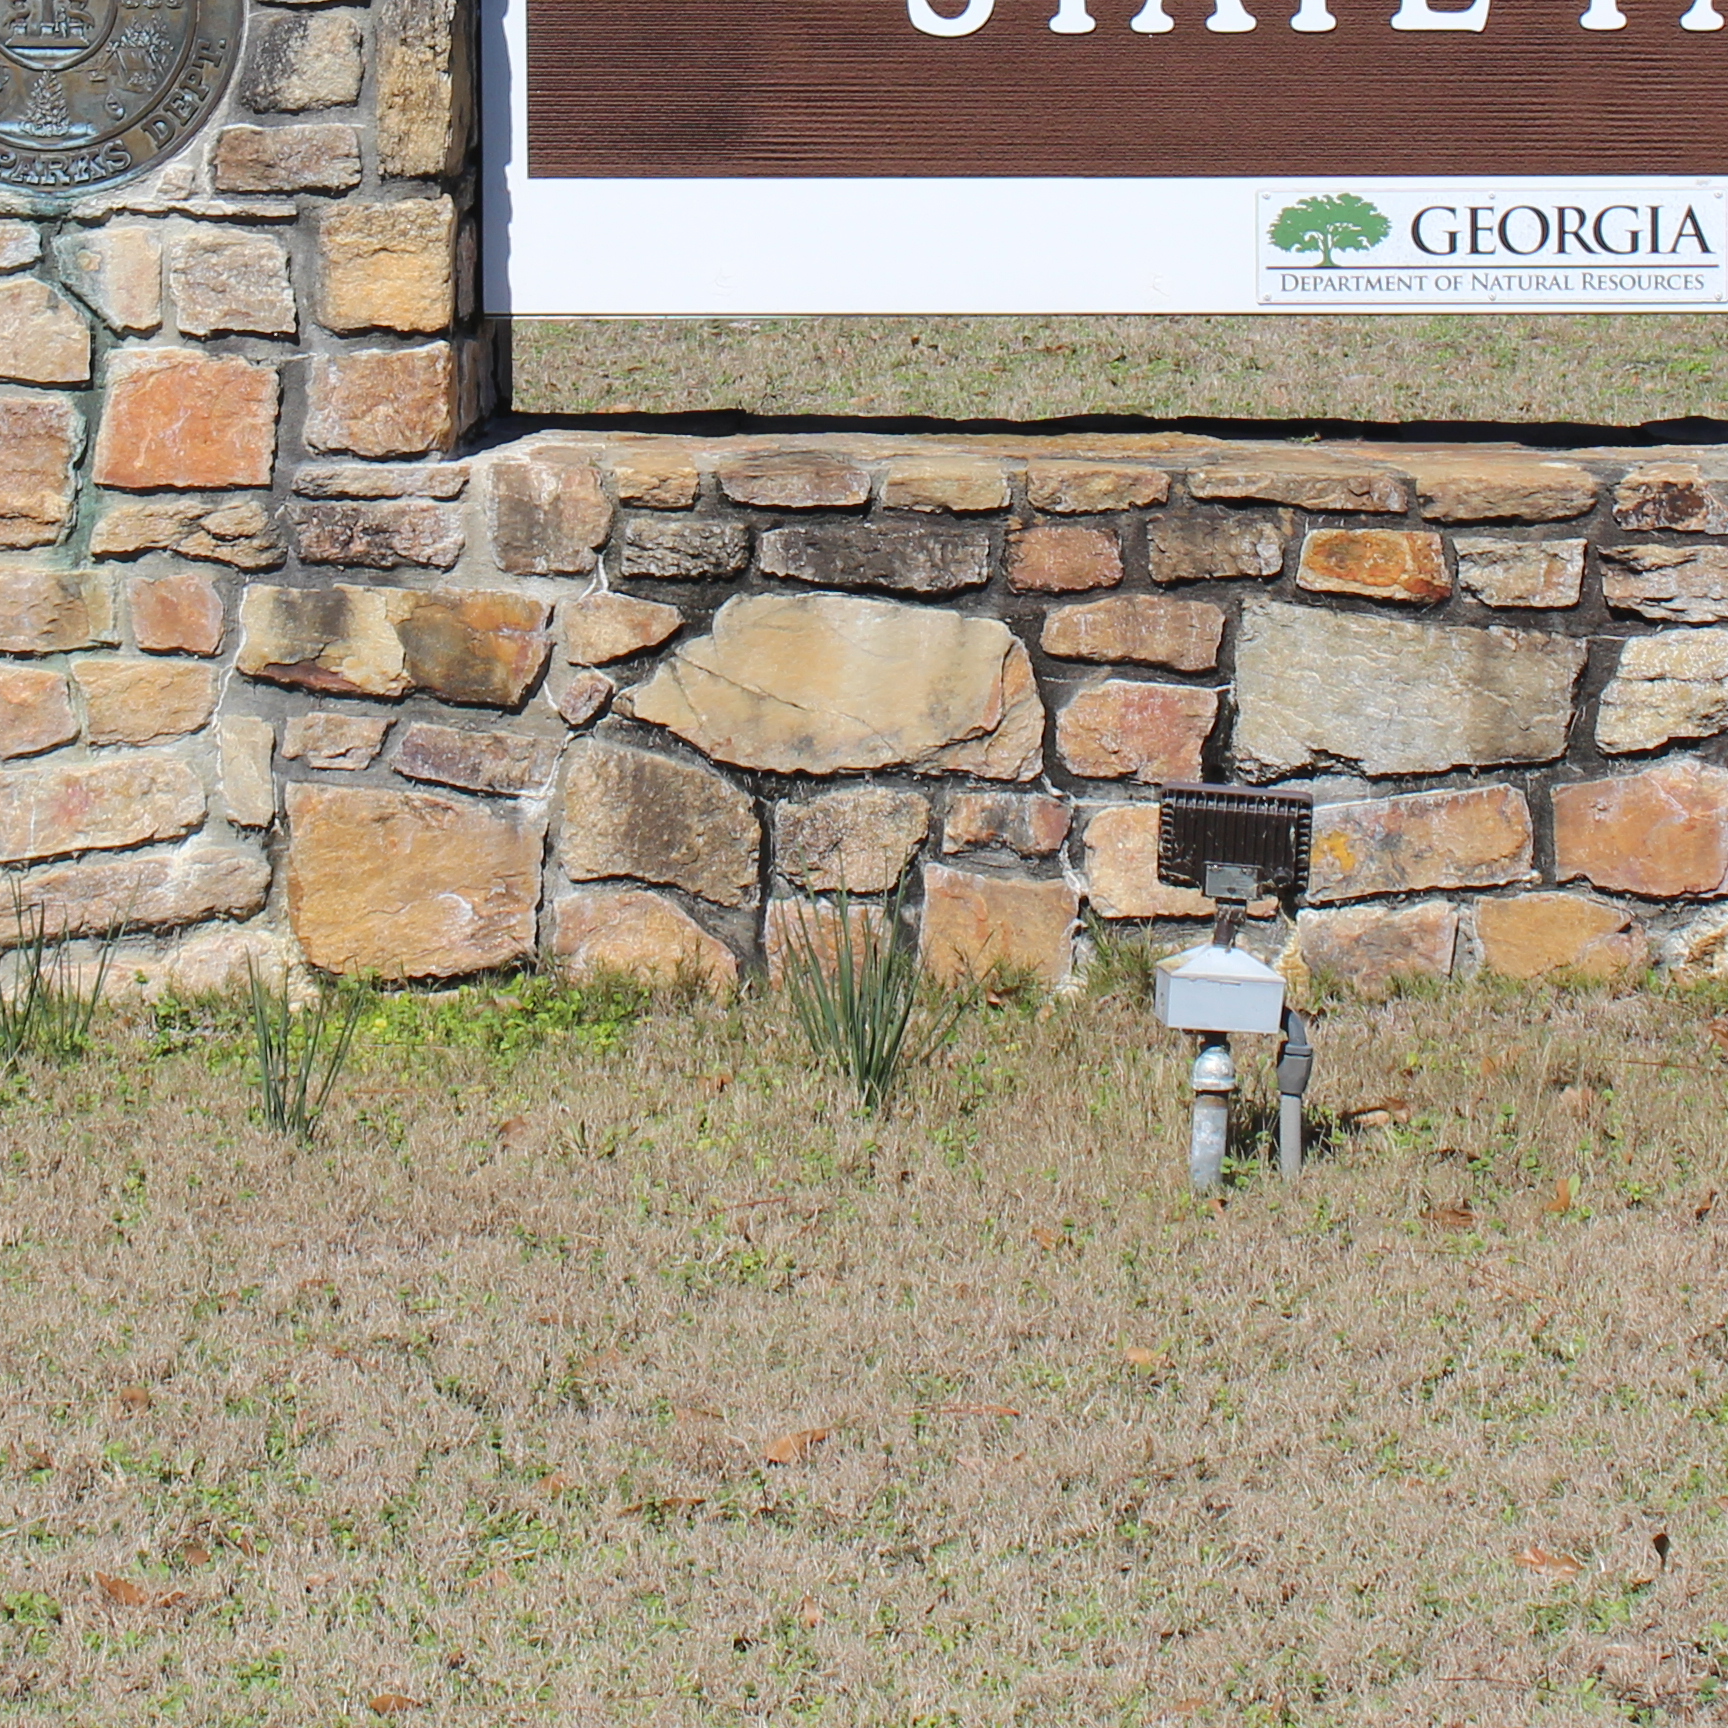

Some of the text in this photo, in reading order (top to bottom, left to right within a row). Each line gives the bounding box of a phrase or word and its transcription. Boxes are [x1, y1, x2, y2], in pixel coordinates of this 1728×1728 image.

[141, 38, 227, 150] DEPT.
[1410, 204, 1715, 256] GEORGIA
[1280, 272, 1705, 292] DEPARTMENT OF NATURAL RESOURCES
